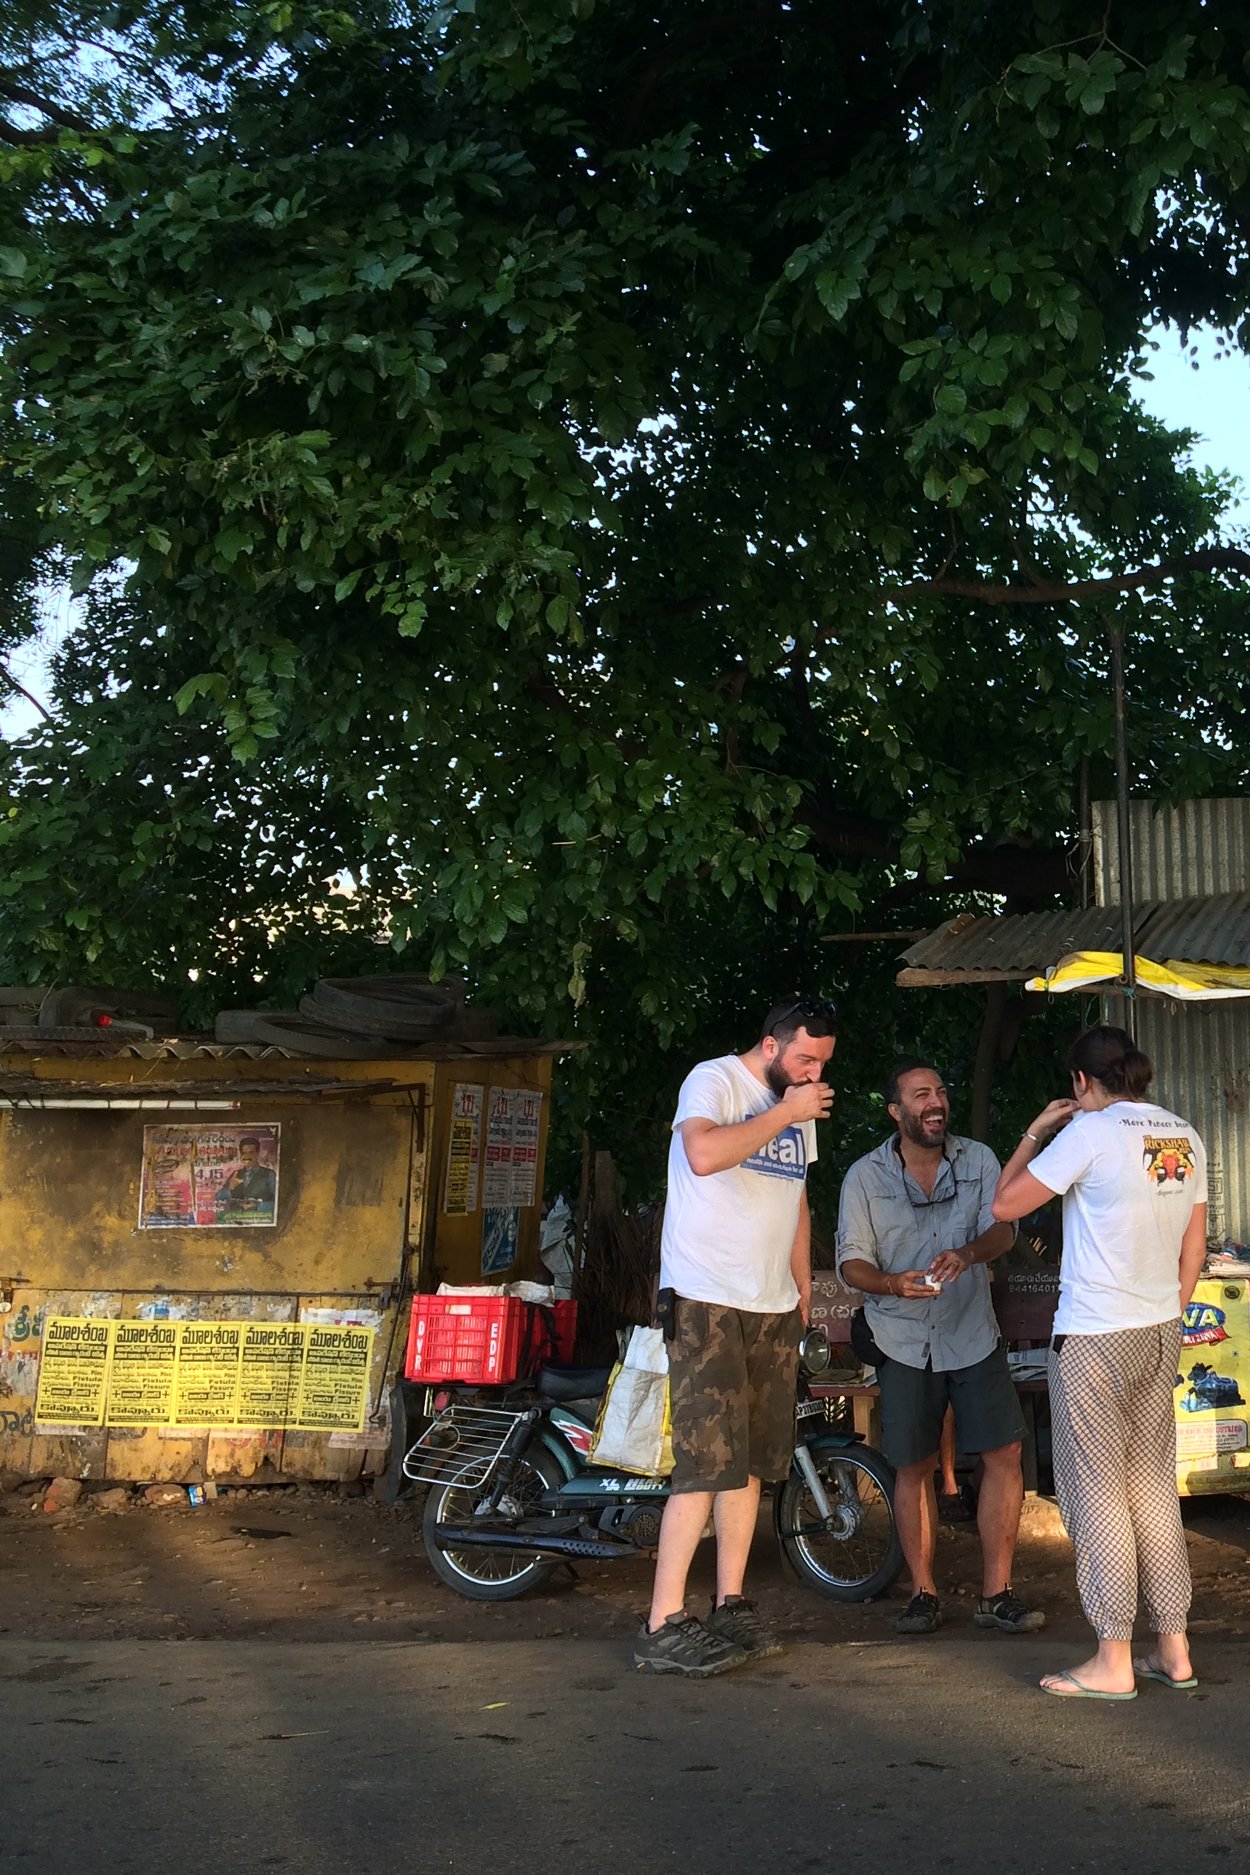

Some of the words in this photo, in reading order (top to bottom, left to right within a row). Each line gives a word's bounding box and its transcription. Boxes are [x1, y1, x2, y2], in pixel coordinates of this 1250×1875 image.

[759, 1134, 804, 1166] eal
[1145, 1138, 1190, 1150] RICKSHAW
[1183, 1309, 1219, 1328] VA
[488, 1323, 498, 1372] EDP
[599, 1479, 619, 1487] XL
[624, 1478, 666, 1490] HEAY
